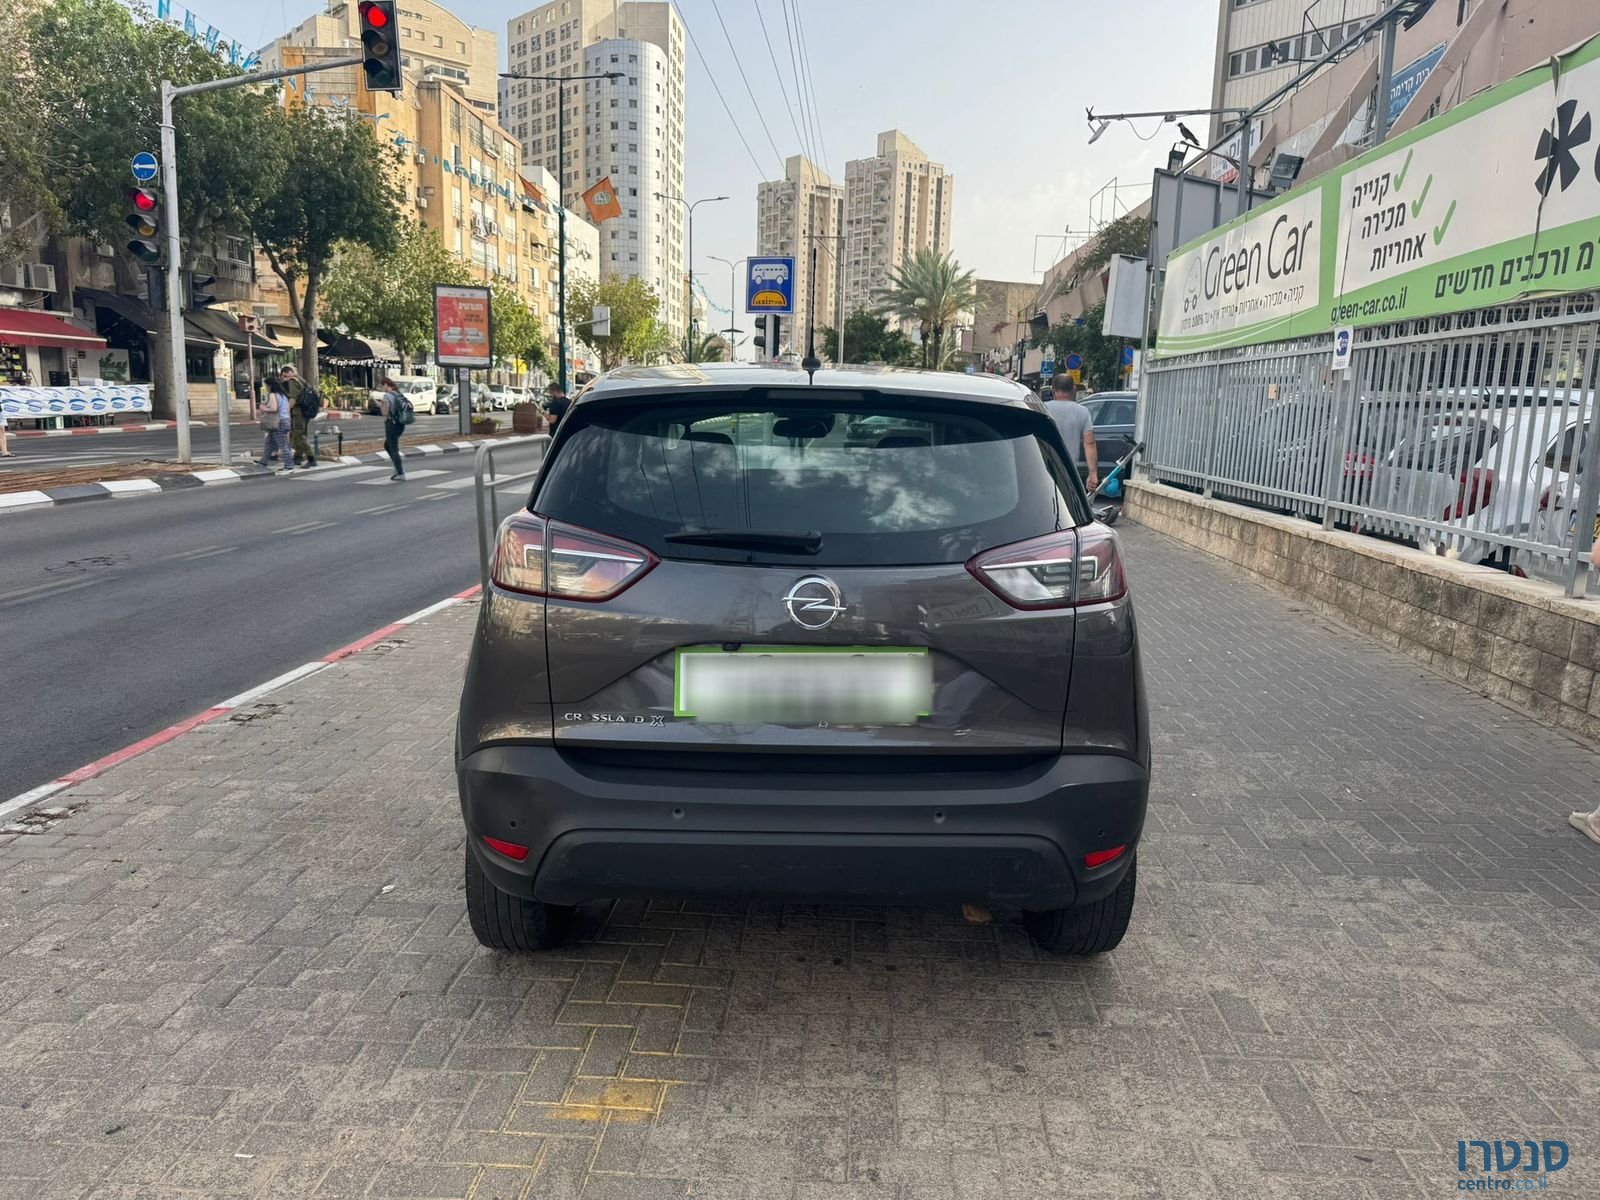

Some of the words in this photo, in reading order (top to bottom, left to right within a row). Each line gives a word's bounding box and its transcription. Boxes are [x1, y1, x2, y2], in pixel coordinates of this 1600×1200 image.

[1391, 76, 1413, 100] קדימה
[1352, 172, 1390, 208] קנייה
[1362, 202, 1406, 239] מכירה
[1205, 242, 1261, 300] Green
[1267, 214, 1313, 279] Car
[1370, 232, 1426, 271] אחריות
[1500, 247, 1570, 286] ורכבים
[1287, 285, 1304, 304] קניה
[1435, 263, 1494, 298] חדשים
[1263, 291, 1282, 308] מכירה
[565, 712, 644, 723] CRSSLAD
[650, 715, 665, 727] X
